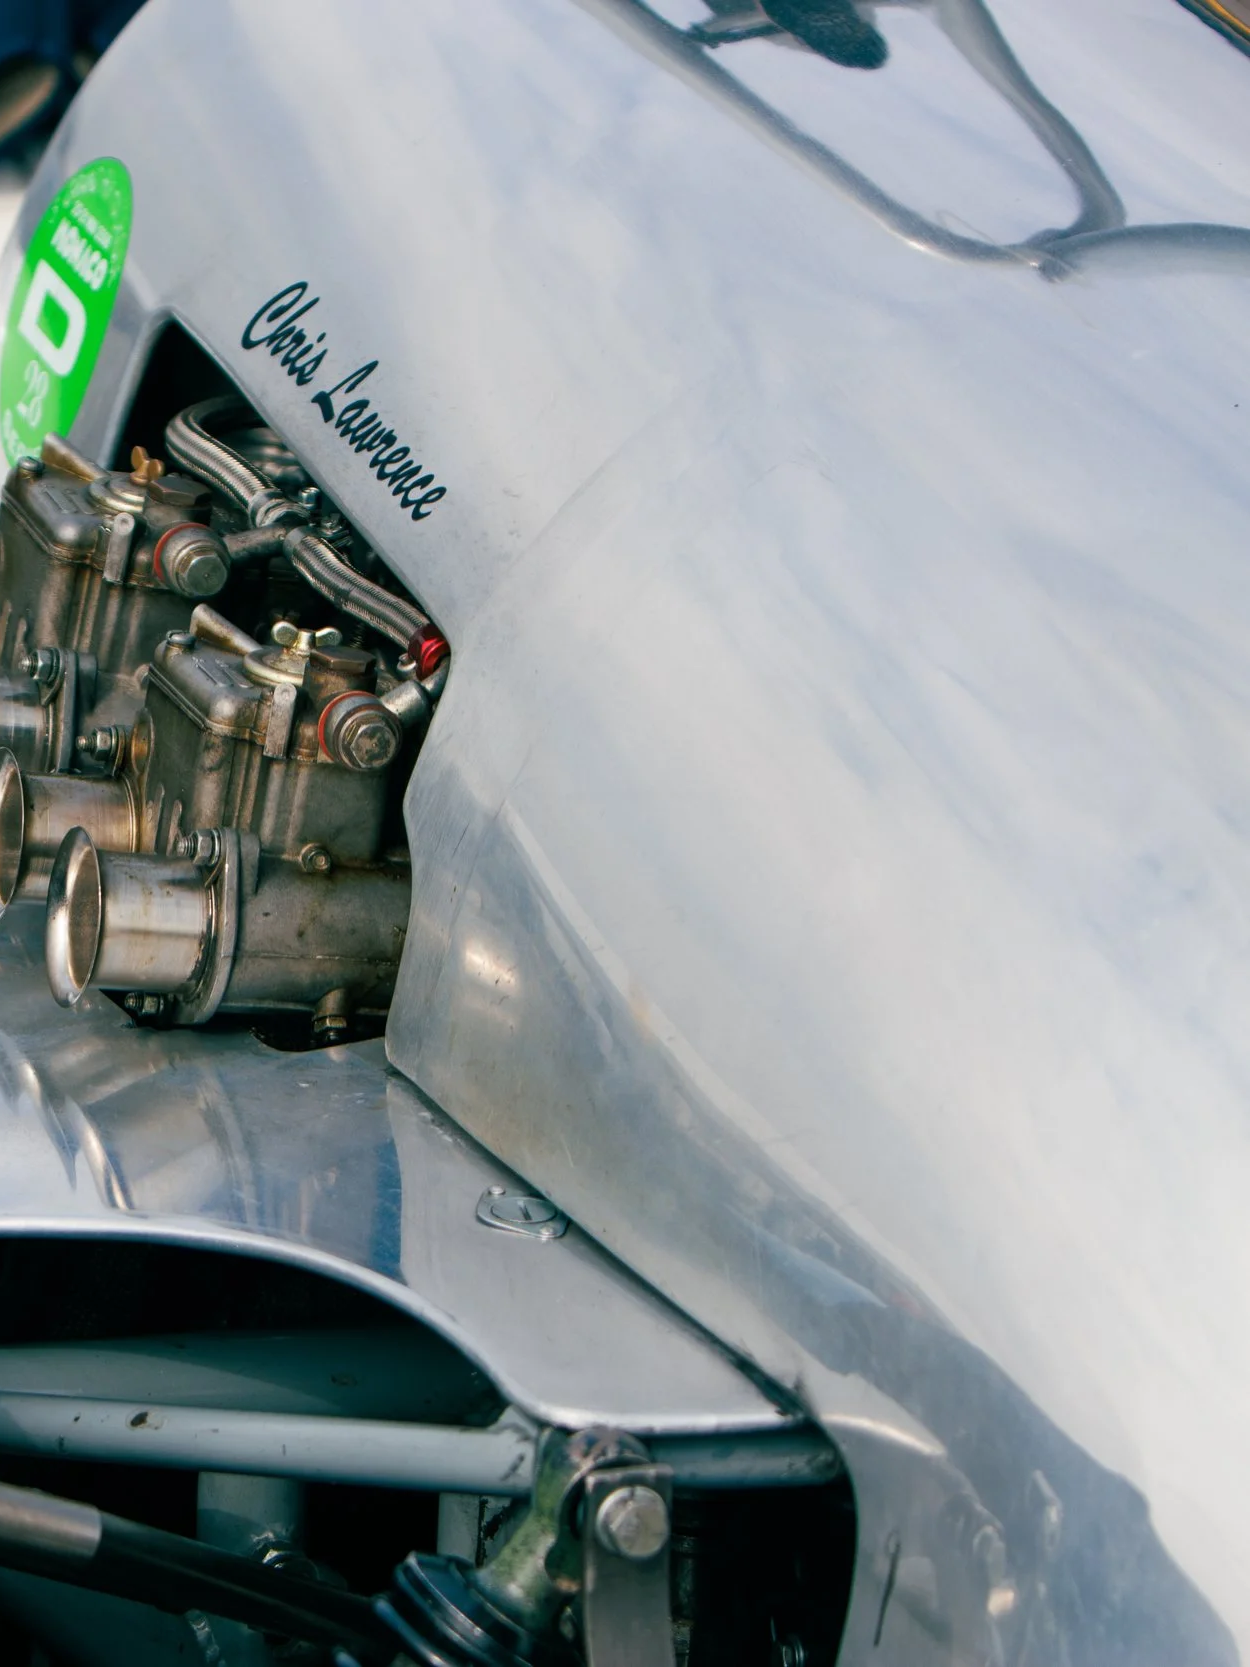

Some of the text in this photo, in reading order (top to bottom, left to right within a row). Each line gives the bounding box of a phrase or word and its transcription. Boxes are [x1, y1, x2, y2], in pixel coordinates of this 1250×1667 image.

[20, 261, 86, 375] D
[241, 281, 447, 521] Chris Lawrence
